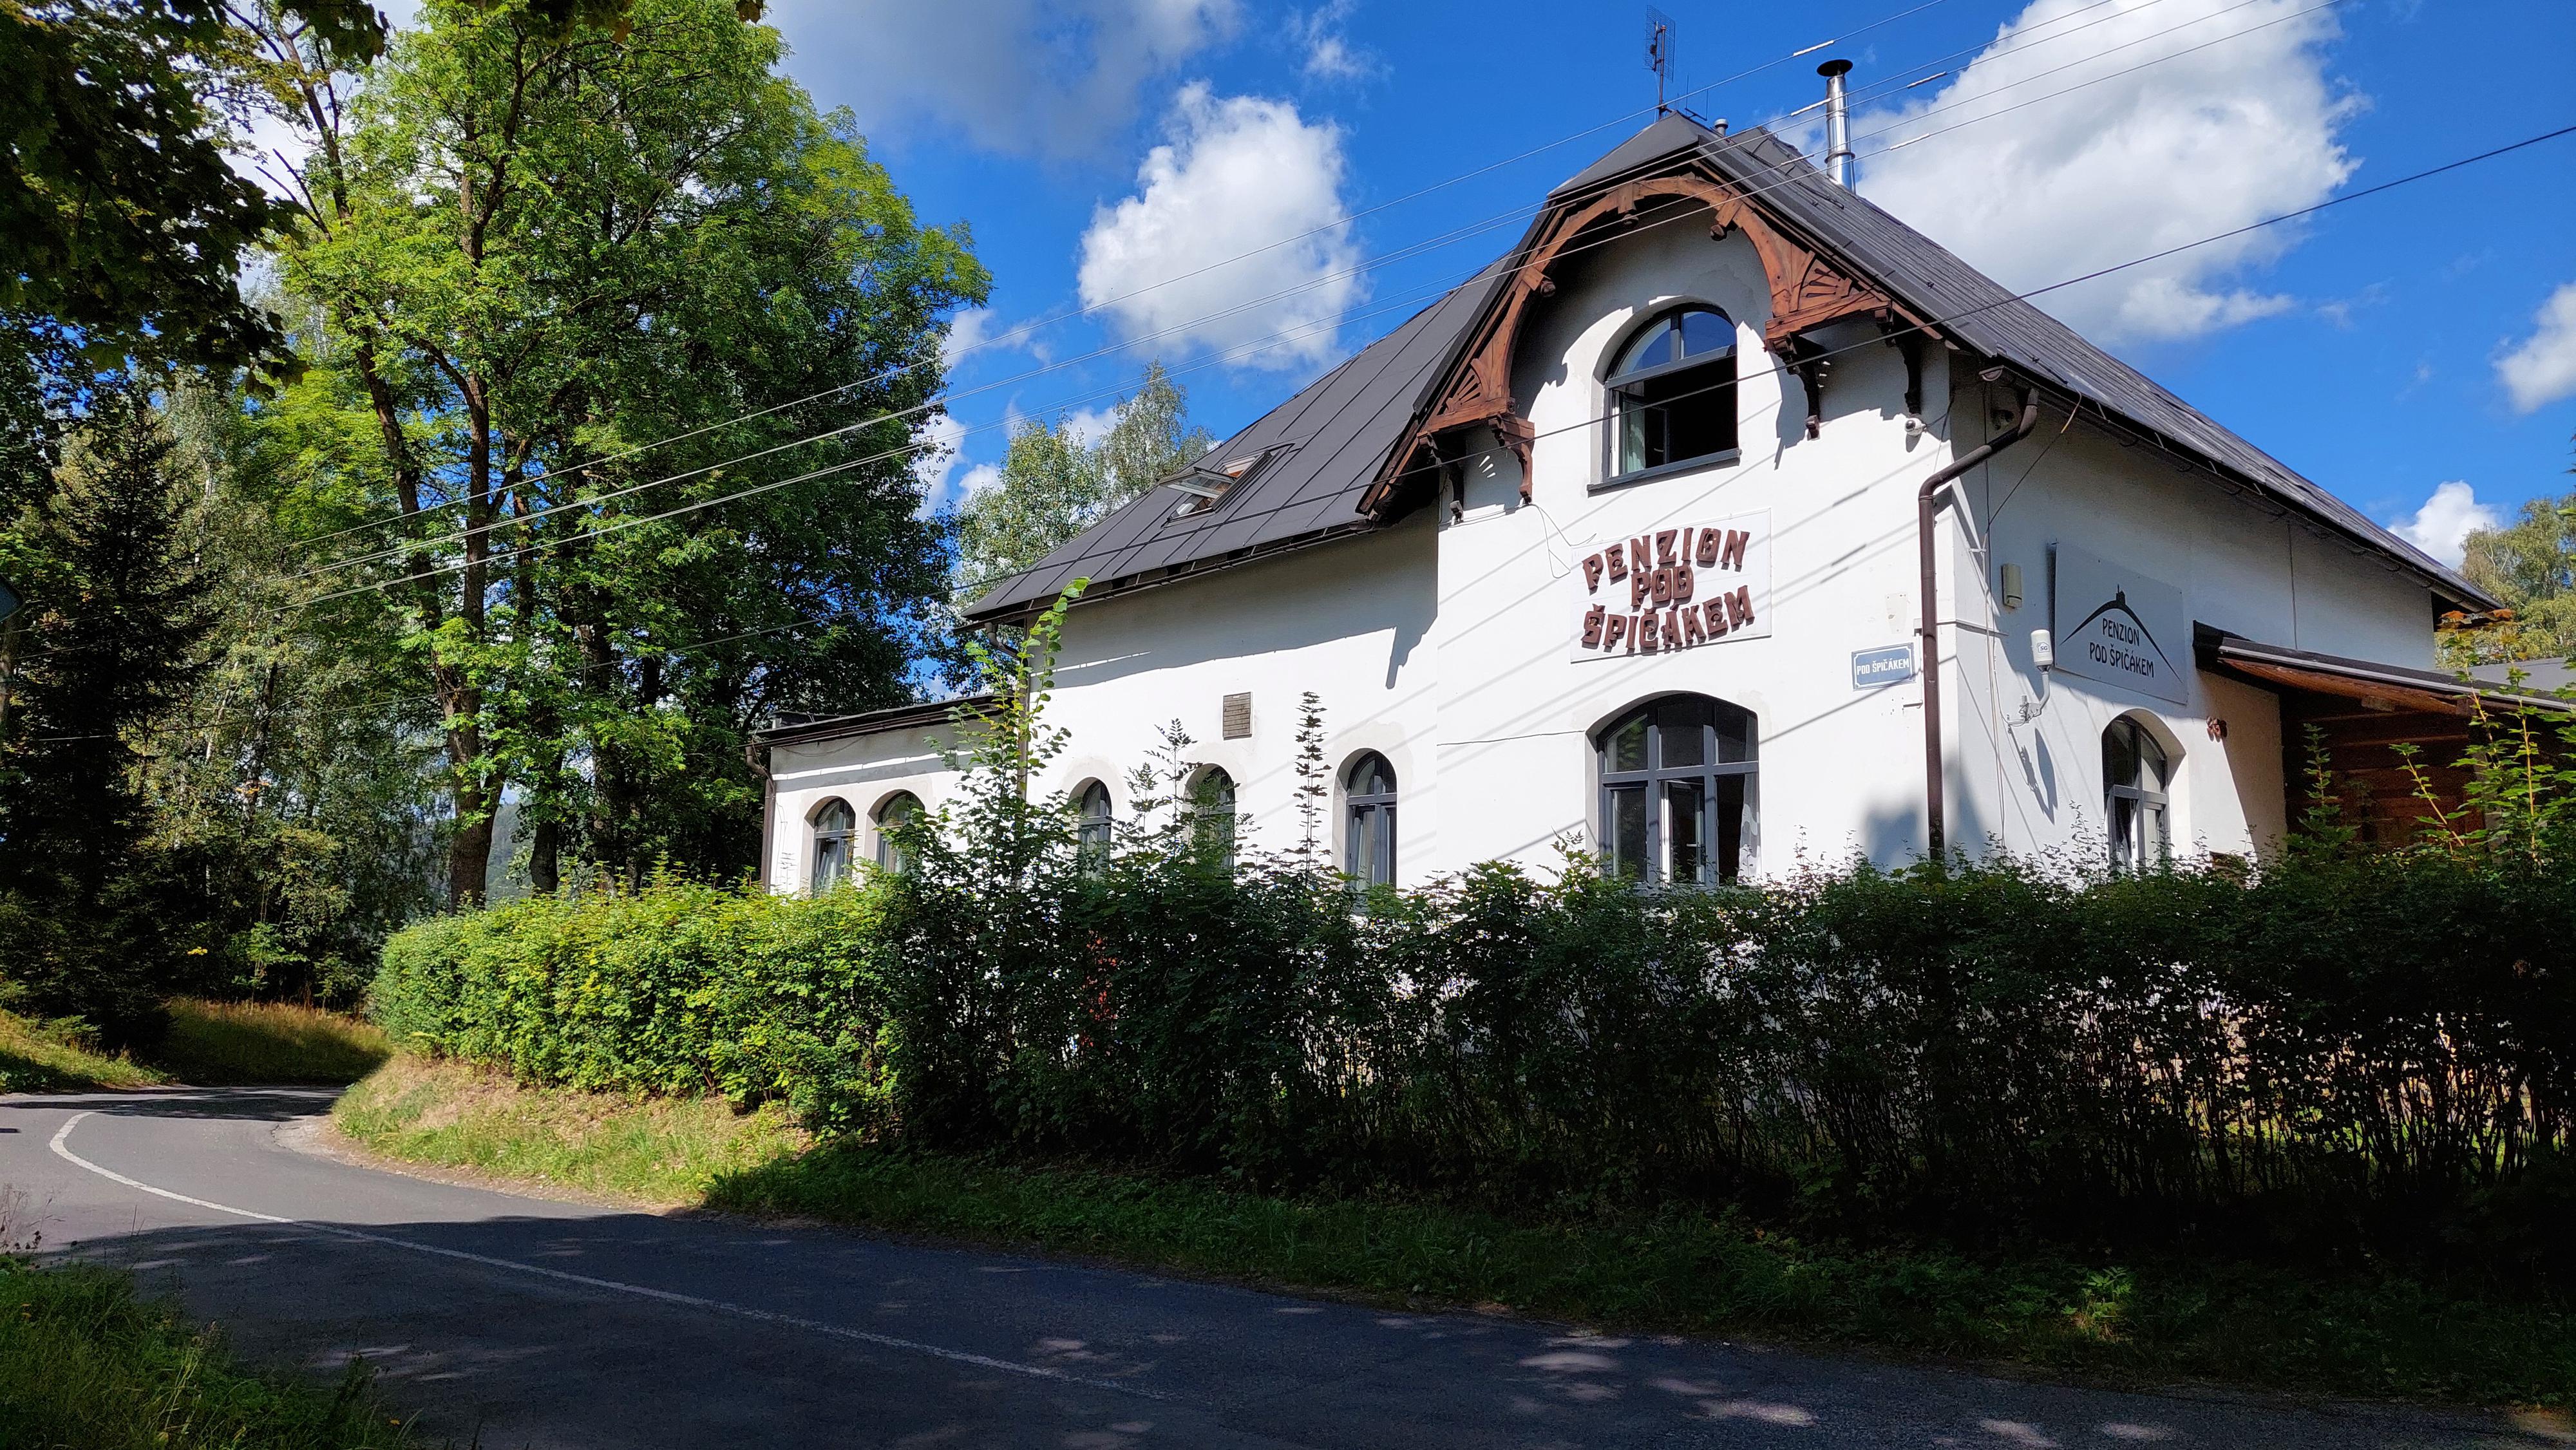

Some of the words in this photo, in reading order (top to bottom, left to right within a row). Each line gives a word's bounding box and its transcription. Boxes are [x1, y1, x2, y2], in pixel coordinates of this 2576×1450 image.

[1582, 527, 1751, 592] PENZION
[1631, 565, 1694, 607] POD
[1581, 585, 1755, 650] ŠPIČÁKEM
[2102, 617, 2139, 646] PENZION
[1857, 664, 1870, 675] POD
[1872, 658, 1909, 672] ŠPIČÁKEM
[2089, 642, 2107, 664] POD
[2109, 643, 2154, 678] ŠPIČÁKEM
